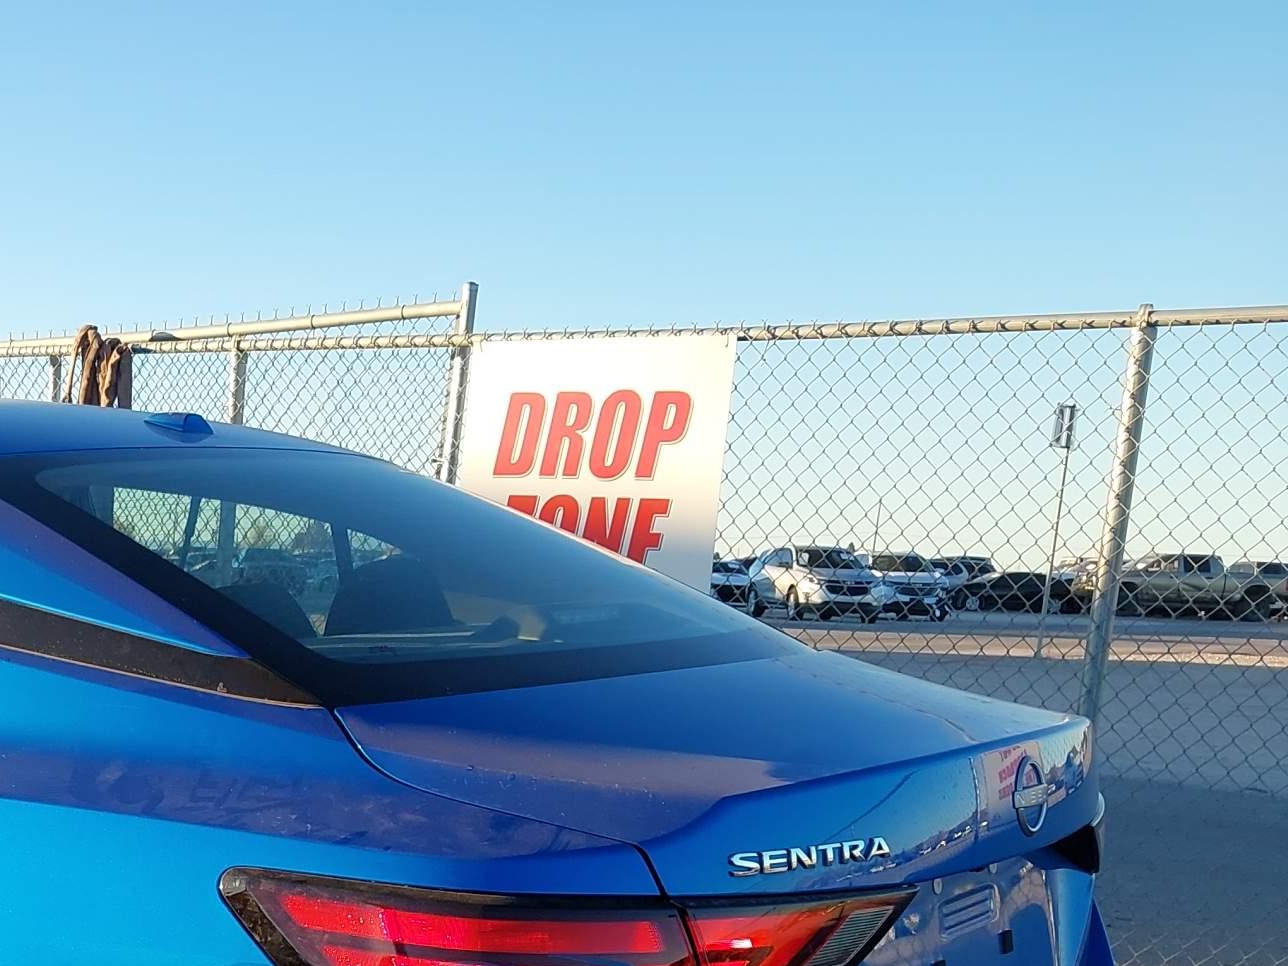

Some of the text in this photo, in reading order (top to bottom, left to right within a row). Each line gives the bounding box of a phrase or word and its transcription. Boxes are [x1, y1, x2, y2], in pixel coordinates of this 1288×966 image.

[492, 389, 695, 481] DROP
[506, 494, 672, 566] NE
[728, 836, 891, 877] SENTRA
